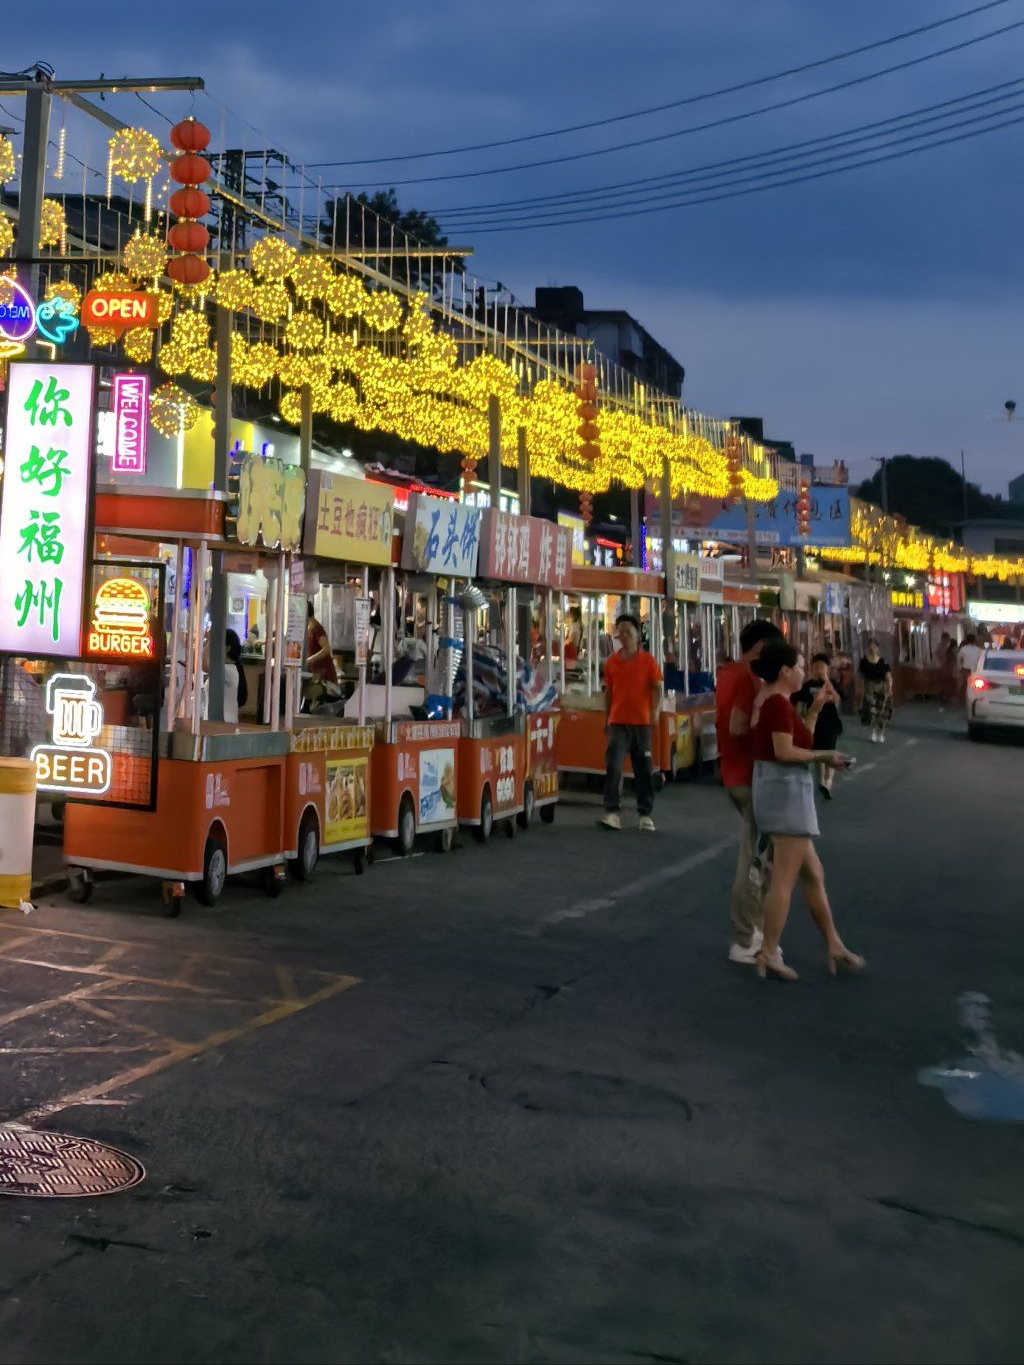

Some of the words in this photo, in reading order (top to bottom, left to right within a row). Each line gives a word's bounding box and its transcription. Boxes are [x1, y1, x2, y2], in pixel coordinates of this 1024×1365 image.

[91, 298, 147, 318] OPEN
[118, 382, 139, 468] WELCOME
[14, 375, 73, 642] 你好福州
[89, 633, 153, 655] BURGER
[35, 752, 104, 784] BEER
